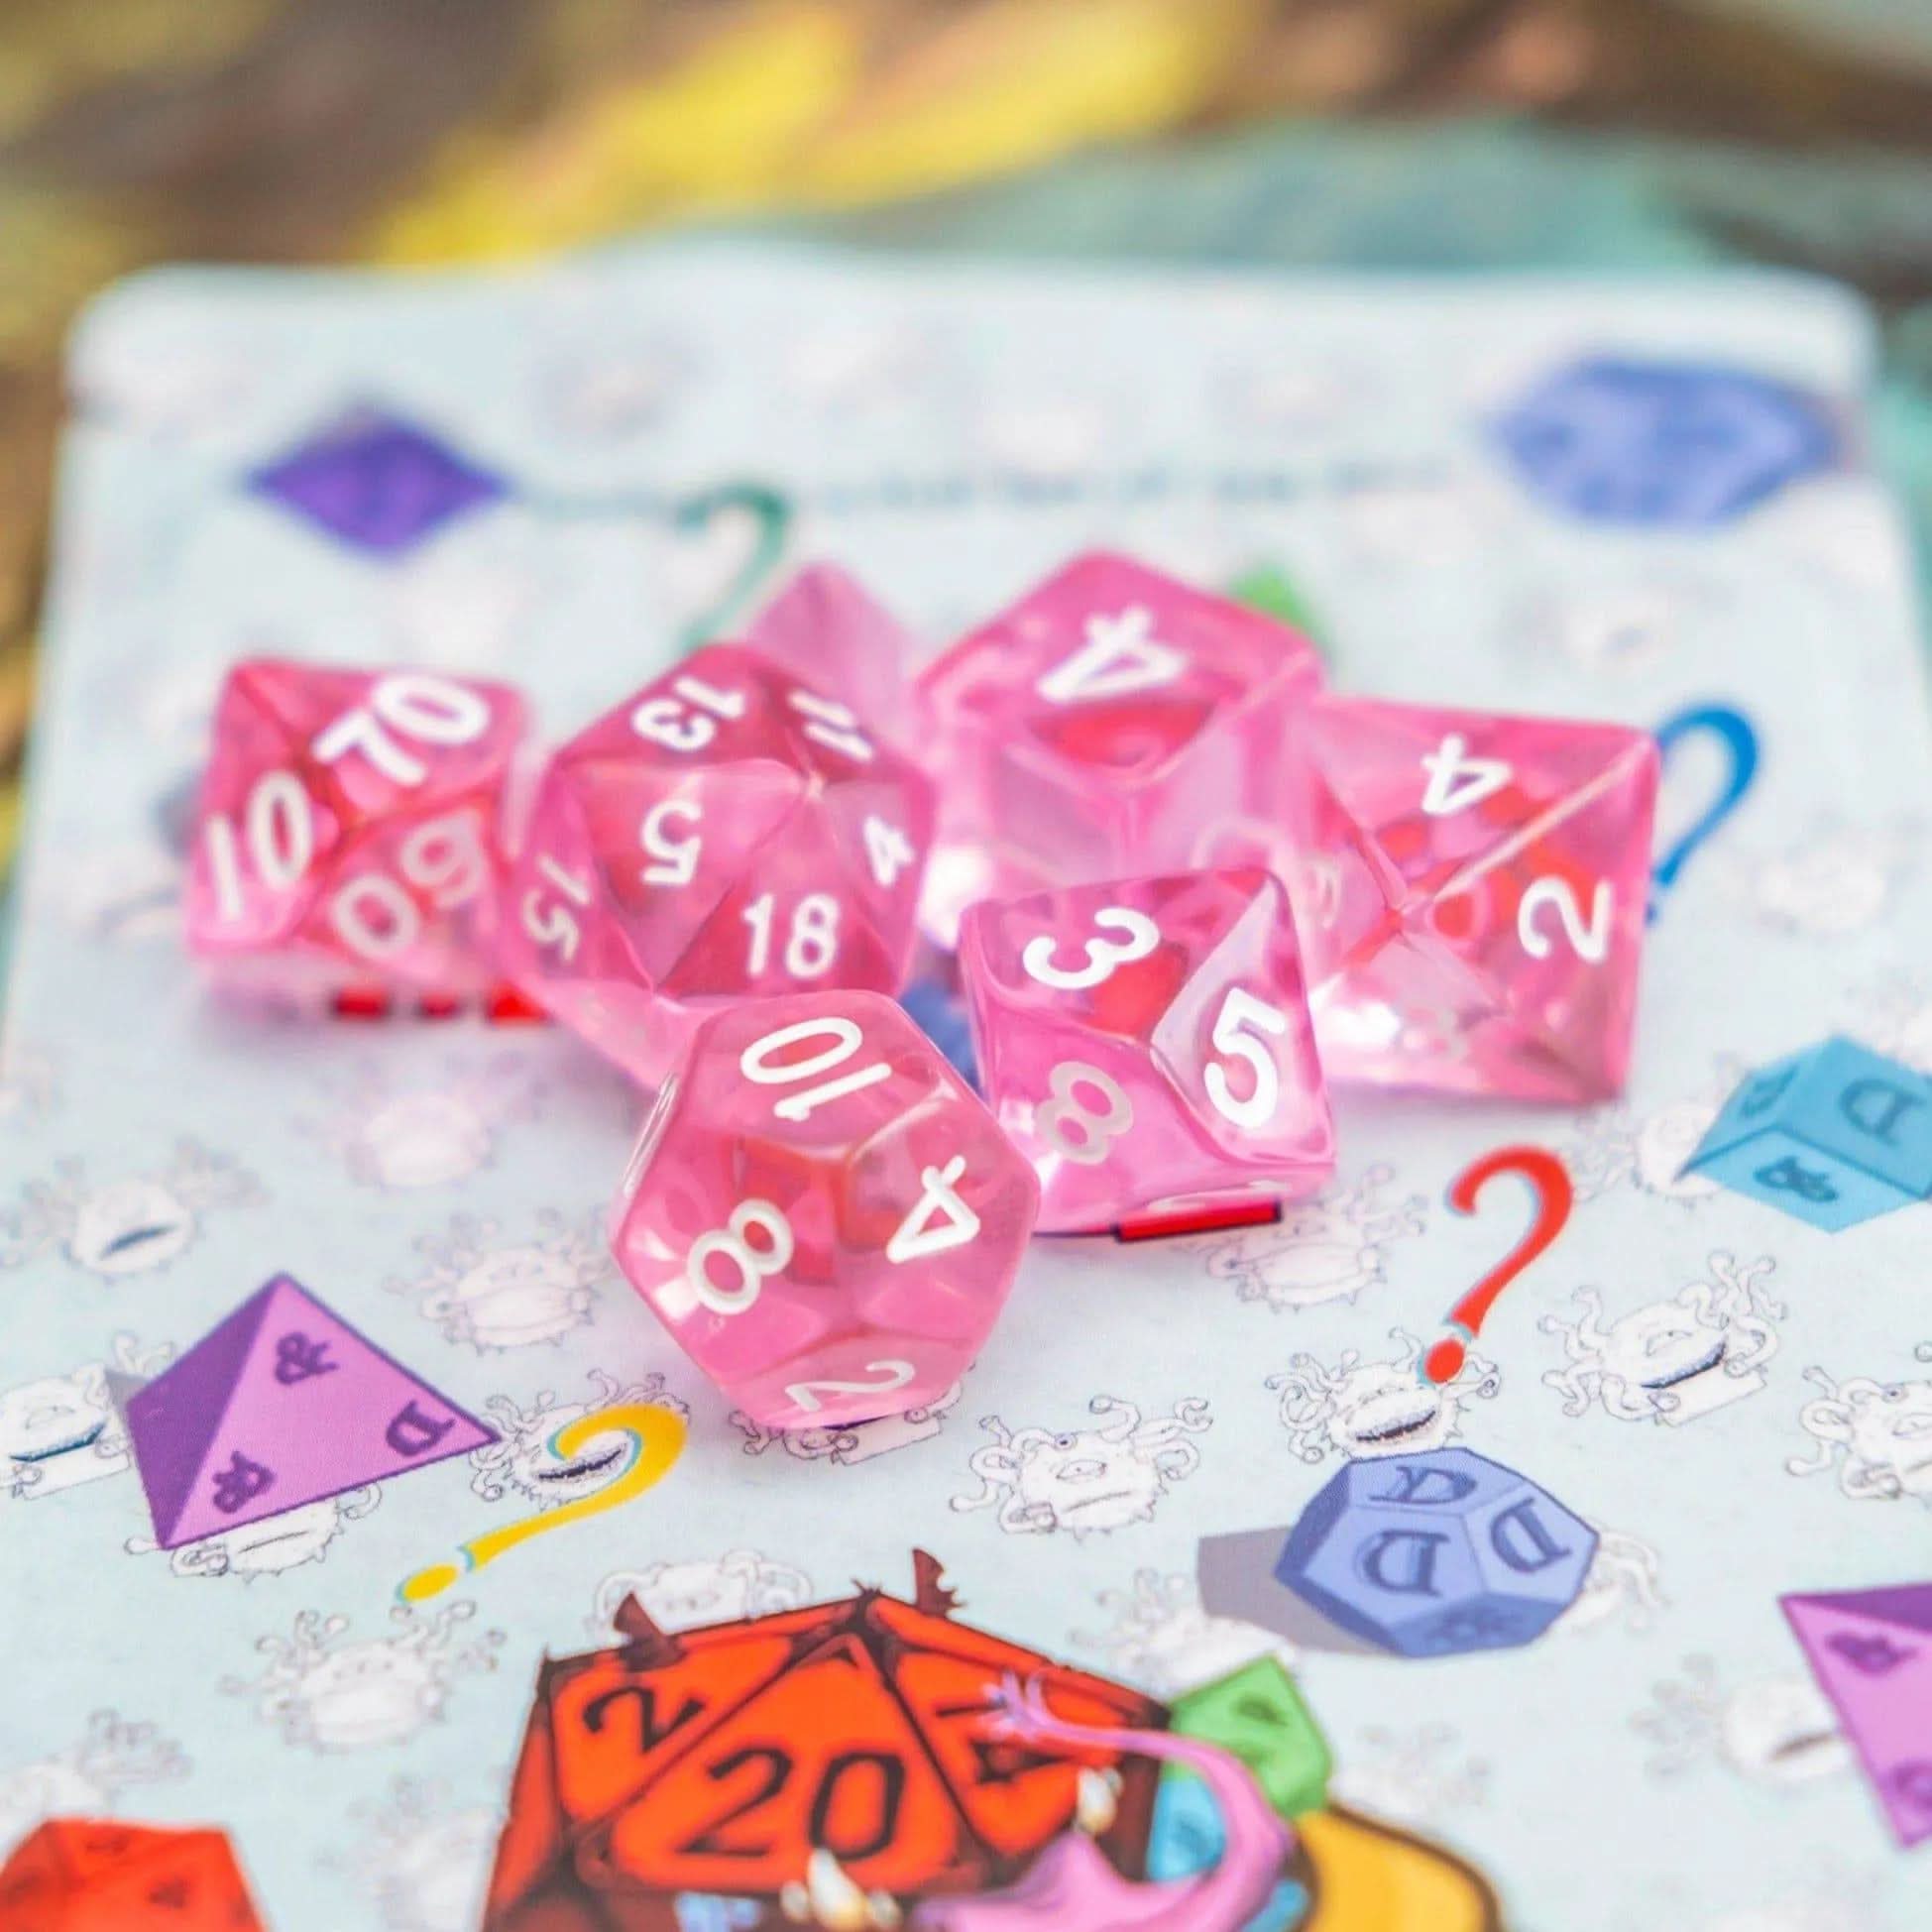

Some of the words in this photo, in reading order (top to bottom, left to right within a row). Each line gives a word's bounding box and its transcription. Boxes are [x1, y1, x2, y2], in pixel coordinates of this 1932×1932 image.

[1037, 607, 1186, 704] 4
[310, 672, 491, 787] 70
[631, 676, 744, 751] 13
[1420, 733, 1512, 817] 4
[204, 770, 314, 922] 10
[639, 799, 703, 887] 5
[861, 815, 915, 888] 4
[522, 853, 592, 963] 15
[741, 894, 840, 978] 18
[1022, 907, 1160, 989] 3
[1517, 874, 1611, 964] 2
[739, 1017, 892, 1121] 10
[1203, 986, 1286, 1128] 5
[1035, 1061, 1133, 1165] 8
[687, 1198, 793, 1314] 8
[886, 1155, 980, 1264] 4
[784, 1360, 916, 1413] 2
[582, 1685, 706, 1756] 2
[673, 1746, 907, 1862] 20
